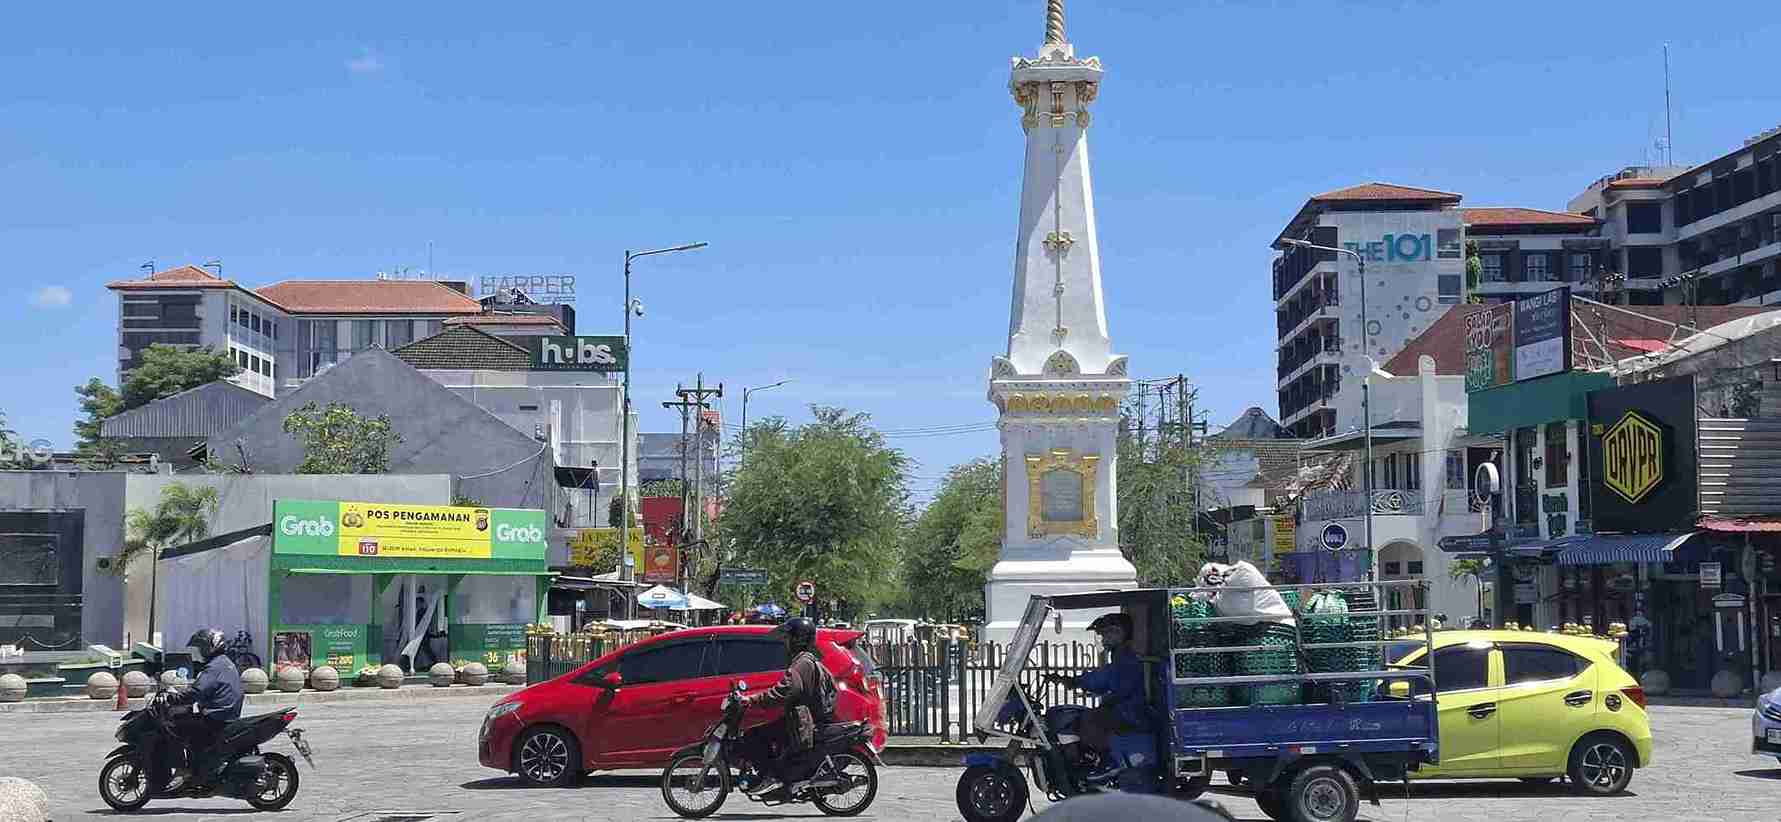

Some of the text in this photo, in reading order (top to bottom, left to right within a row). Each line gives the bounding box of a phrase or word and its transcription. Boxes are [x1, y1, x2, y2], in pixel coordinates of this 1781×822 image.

[1383, 233, 1431, 261] 101
[480, 275, 575, 294] HARPER
[280, 515, 335, 537] Grab
[367, 510, 471, 522] POS PENGAMANAN
[496, 523, 543, 543] Grab
